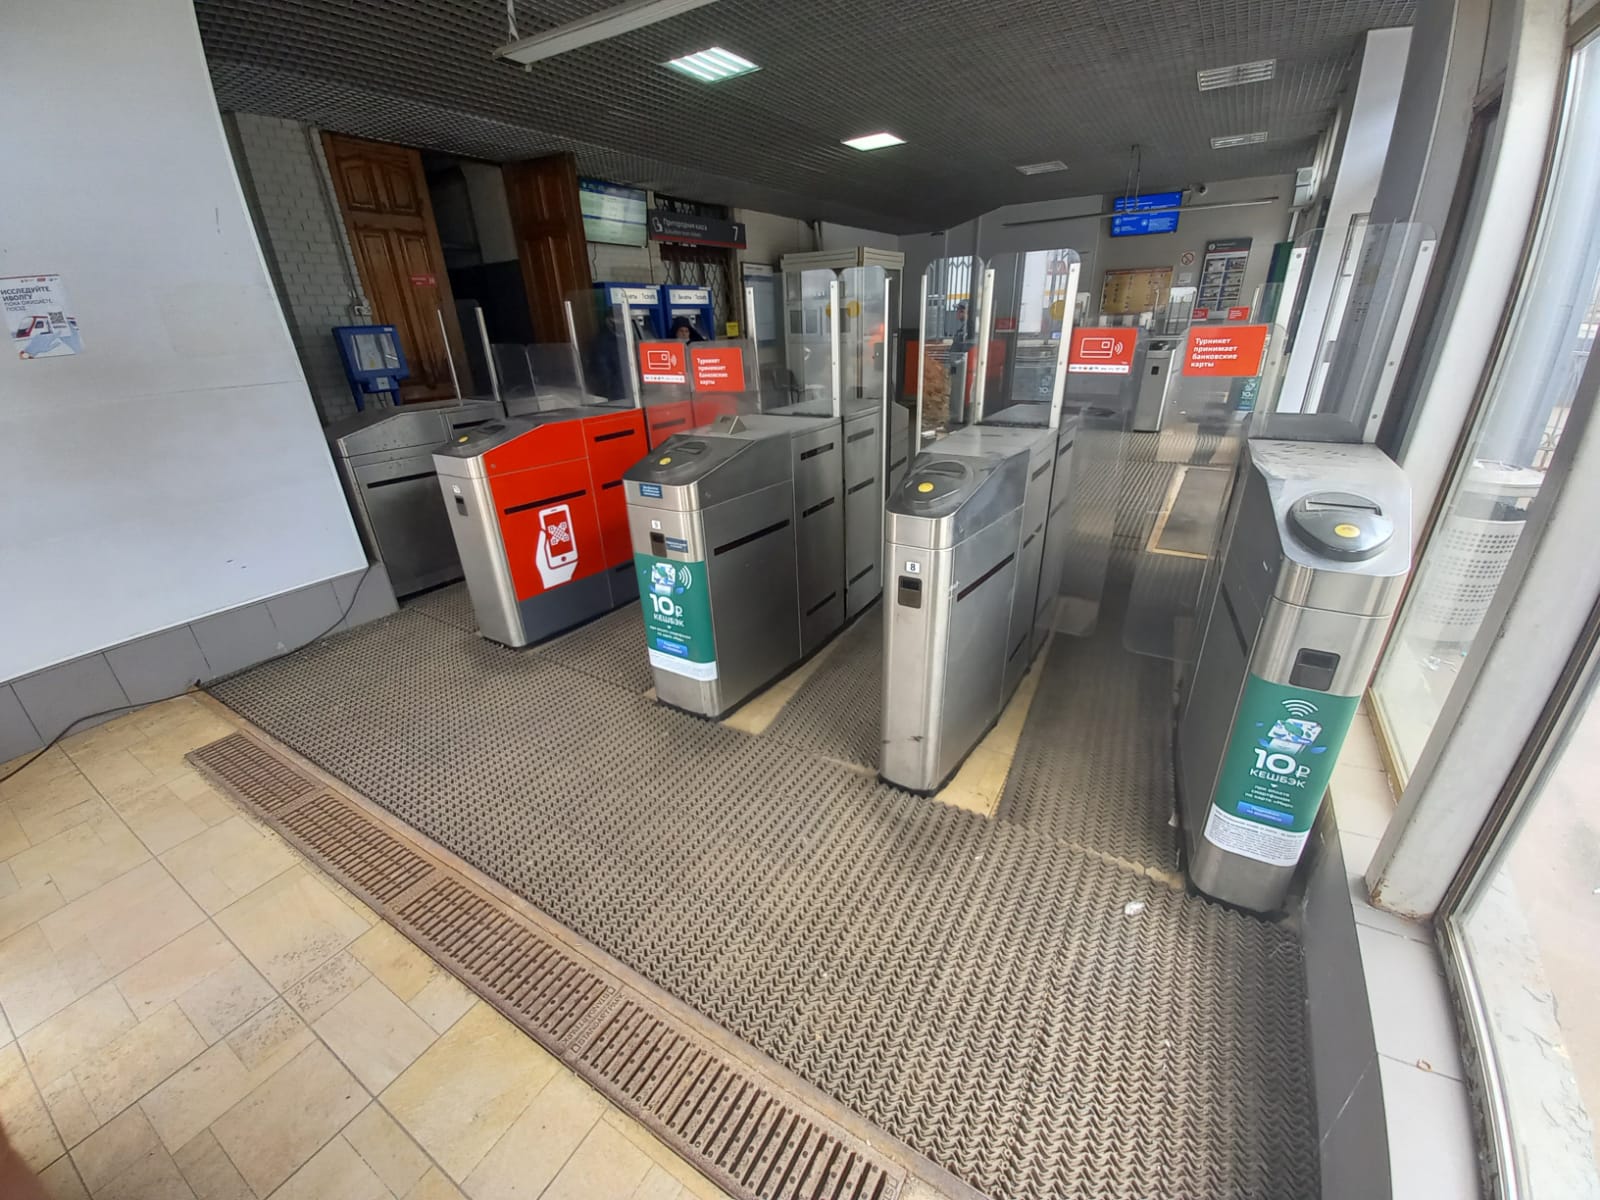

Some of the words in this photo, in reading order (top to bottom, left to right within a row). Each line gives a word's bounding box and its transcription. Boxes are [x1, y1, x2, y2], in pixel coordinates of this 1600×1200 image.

[732, 225, 738, 241] 7
[0, 286, 51, 295] ИССЛЕДУЙТЕ
[1194, 337, 1232, 346] Турникет
[1191, 352, 1238, 360] банковские
[653, 612, 685, 628] КЕШБЭК
[1249, 768, 1307, 789] КЕШБЭК
